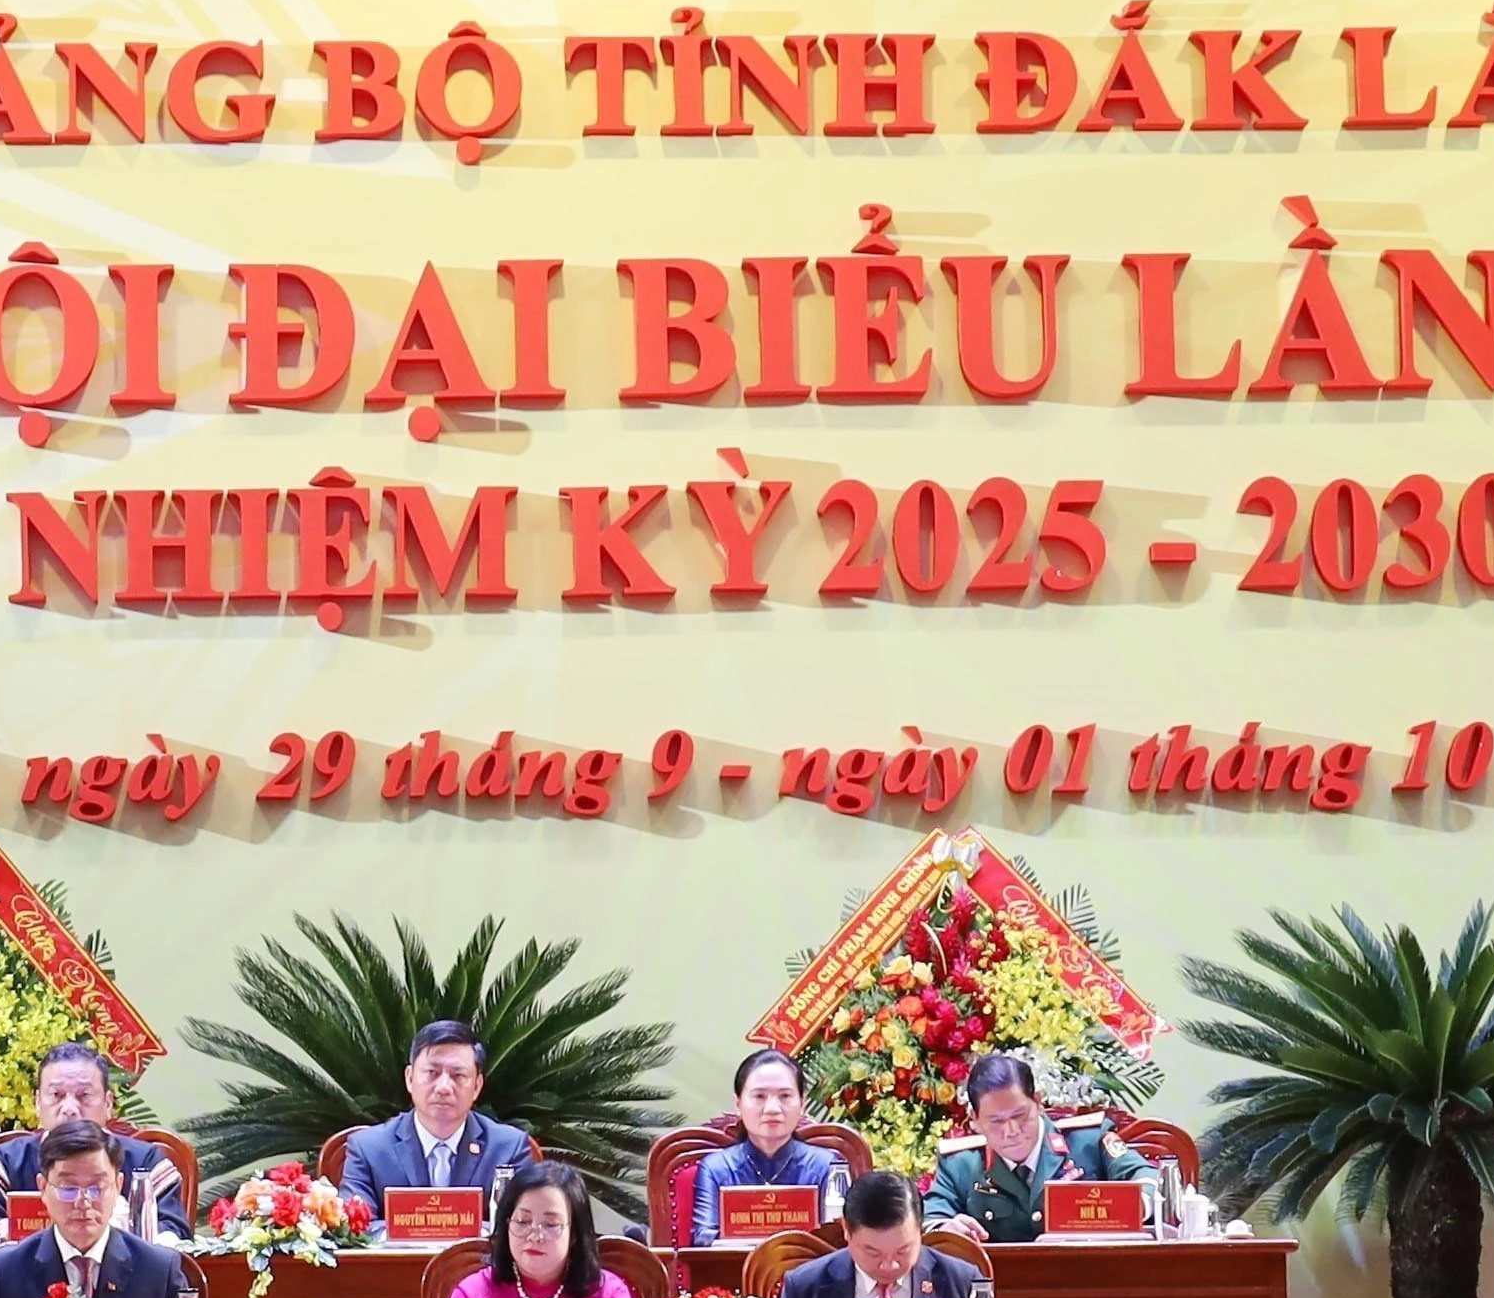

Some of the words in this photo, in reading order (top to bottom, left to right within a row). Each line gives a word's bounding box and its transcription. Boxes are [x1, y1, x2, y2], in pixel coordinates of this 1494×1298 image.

[317, 25, 519, 164] BỘ
[568, 9, 934, 136] TỈNH
[977, 3, 1305, 133] ĐẮK
[229, 261, 565, 442] ĐẠI
[618, 205, 1068, 406] BIỂU
[7, 468, 517, 632] NHIỆM
[560, 449, 790, 607] KỲ
[818, 478, 1105, 601] 2025
[1150, 543, 1196, 572] -
[22, 735, 220, 825] ngày
[256, 732, 355, 806] 29
[382, 732, 621, 818] tháng
[648, 731, 693, 802] 9
[720, 766, 750, 787] -
[780, 727, 977, 817] ngày
[1004, 726, 1094, 800] 01
[1129, 723, 1370, 811] tháng
[1394, 722, 1493, 794] 10
[785, 981, 820, 1019] ĐỒNG
[817, 955, 841, 983] CHÍ
[835, 922, 873, 961] PHẠM
[867, 890, 901, 926] MINH
